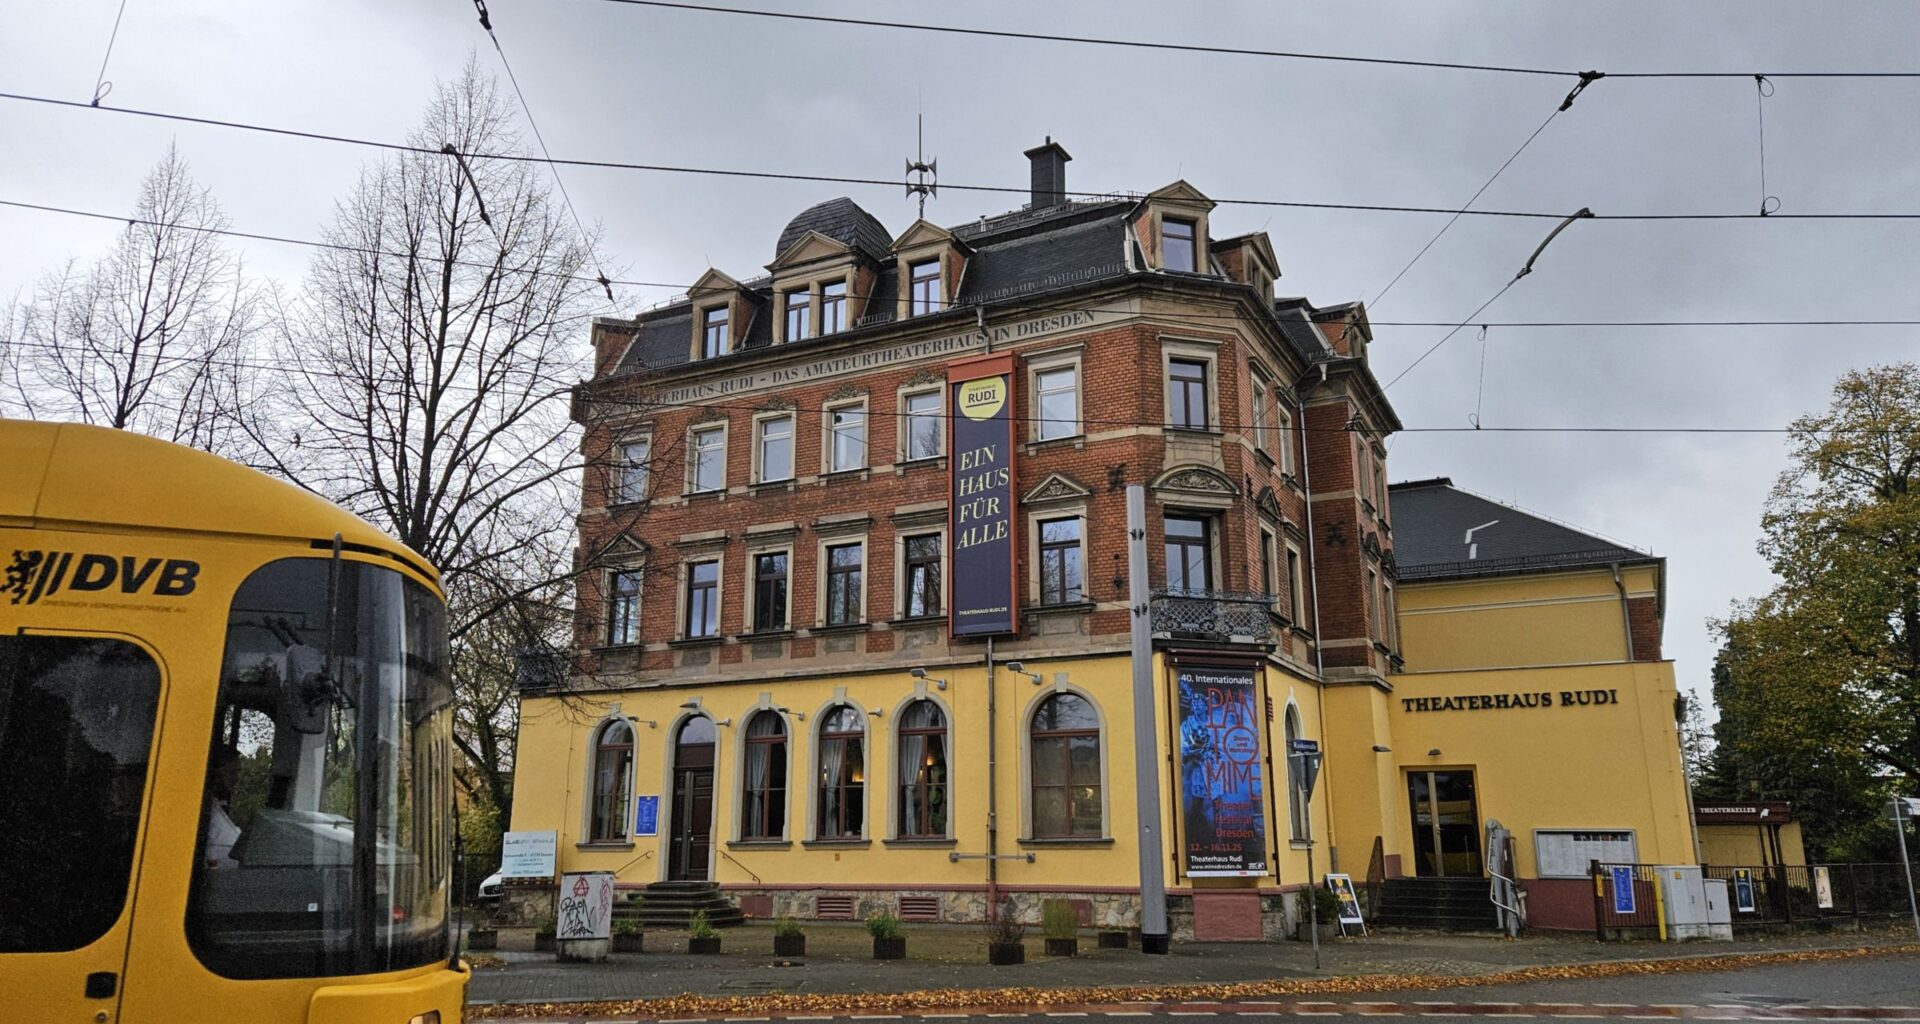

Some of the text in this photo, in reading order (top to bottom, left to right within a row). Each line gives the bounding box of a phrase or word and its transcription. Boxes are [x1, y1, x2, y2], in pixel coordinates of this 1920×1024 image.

[720, 376, 754, 394] RUDI
[772, 367, 799, 384] DAS
[802, 332, 985, 378] AMATEURTHEATERHAUS
[994, 327, 1011, 341] IN
[1017, 310, 1095, 337] DRESDEN
[968, 389, 996, 404] RUDI
[960, 444, 996, 472] EIN
[959, 467, 1009, 497] HAUS
[959, 497, 1001, 524] FÜR
[956, 520, 1008, 549] ALLE
[68, 553, 201, 597] DVB
[1181, 674, 1253, 685] 40. Internationales
[1206, 687, 1258, 728] PAN
[1402, 688, 1618, 712] THEATERHAUS RUDI
[1205, 760, 1262, 801] MIME
[1215, 828, 1254, 838] Dresden
[1190, 843, 1202, 852] 12.
